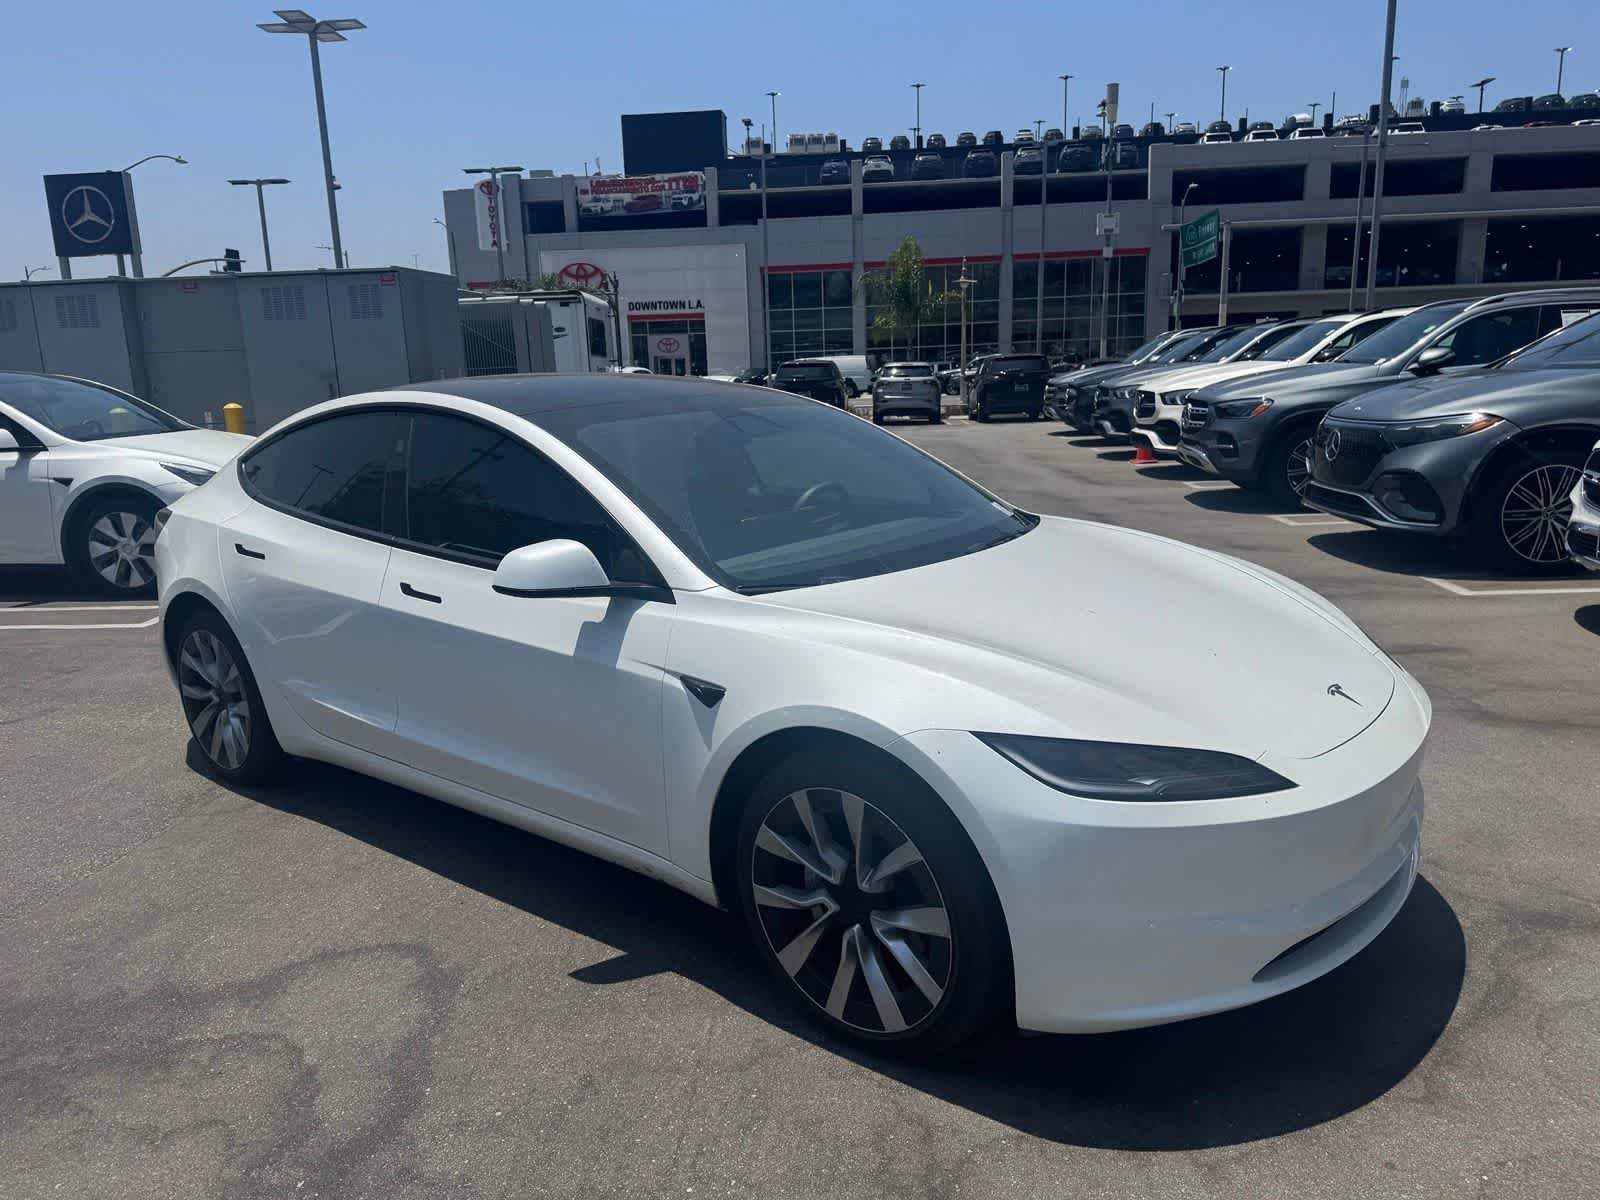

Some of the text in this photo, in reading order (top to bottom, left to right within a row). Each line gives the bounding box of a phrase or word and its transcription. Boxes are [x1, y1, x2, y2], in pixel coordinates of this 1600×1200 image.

[488, 197, 498, 248] TOYOTA
[628, 299, 705, 311] DOWNTOWN L.A.
